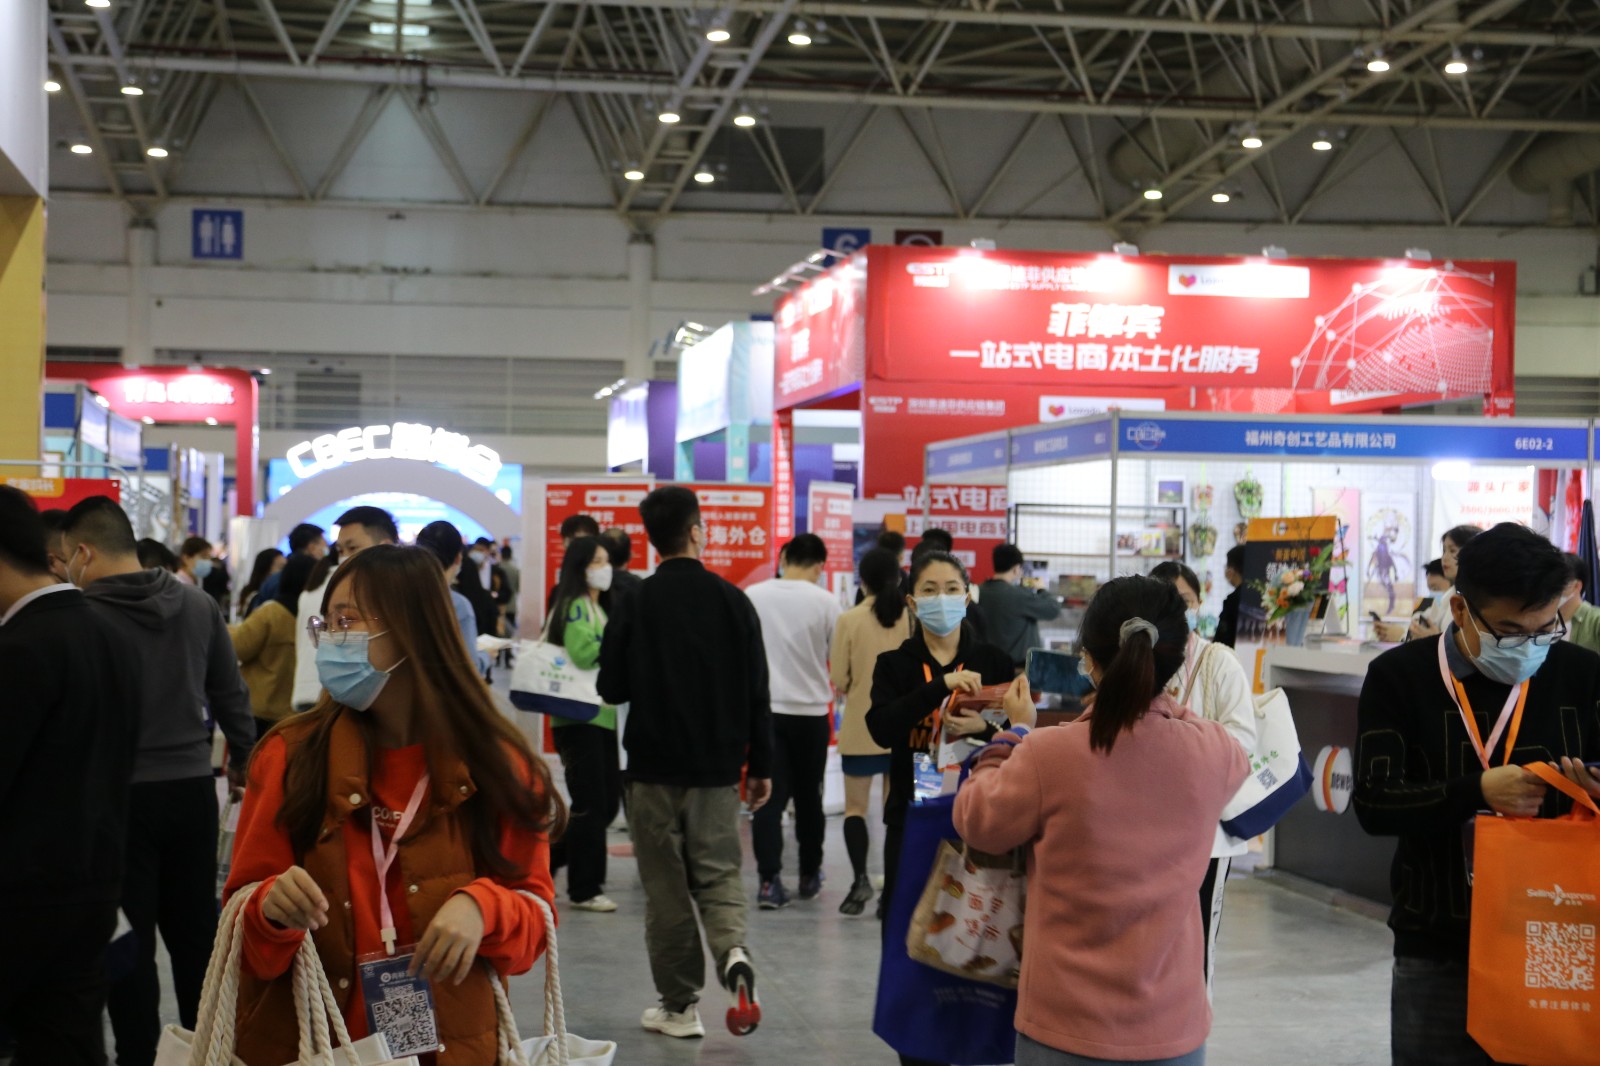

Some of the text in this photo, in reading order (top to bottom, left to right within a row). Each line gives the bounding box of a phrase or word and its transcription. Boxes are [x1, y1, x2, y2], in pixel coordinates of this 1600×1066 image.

[1047, 302, 1165, 339] 菲律宾
[949, 340, 1260, 375] 一站式电商本土化服务
[1245, 430, 1396, 449] 福州奇创工艺品有限公司
[1514, 437, 1554, 450] 6E02-2
[698, 524, 767, 547] 海外仓
[1330, 771, 1354, 792] newe
